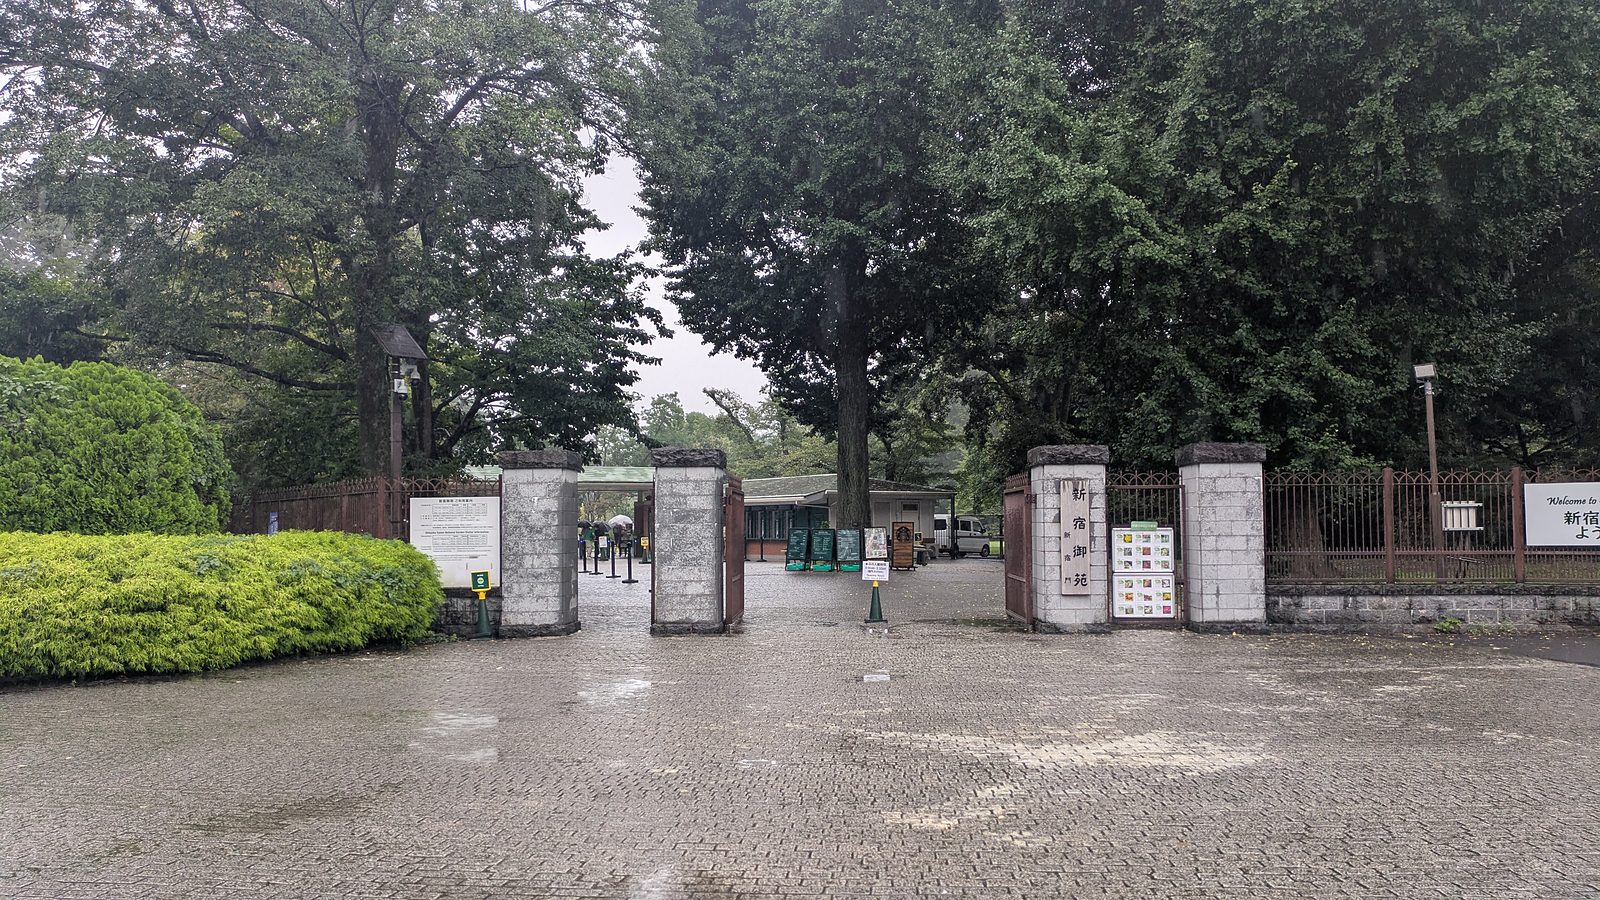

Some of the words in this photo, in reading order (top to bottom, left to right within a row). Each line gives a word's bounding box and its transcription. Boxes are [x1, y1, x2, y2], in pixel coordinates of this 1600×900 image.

[1547, 496, 1586, 505] Welcome
[1589, 497, 1597, 505] to
[1564, 511, 1599, 525] 新宿
[1072, 488, 1087, 586] 新宿御苑
